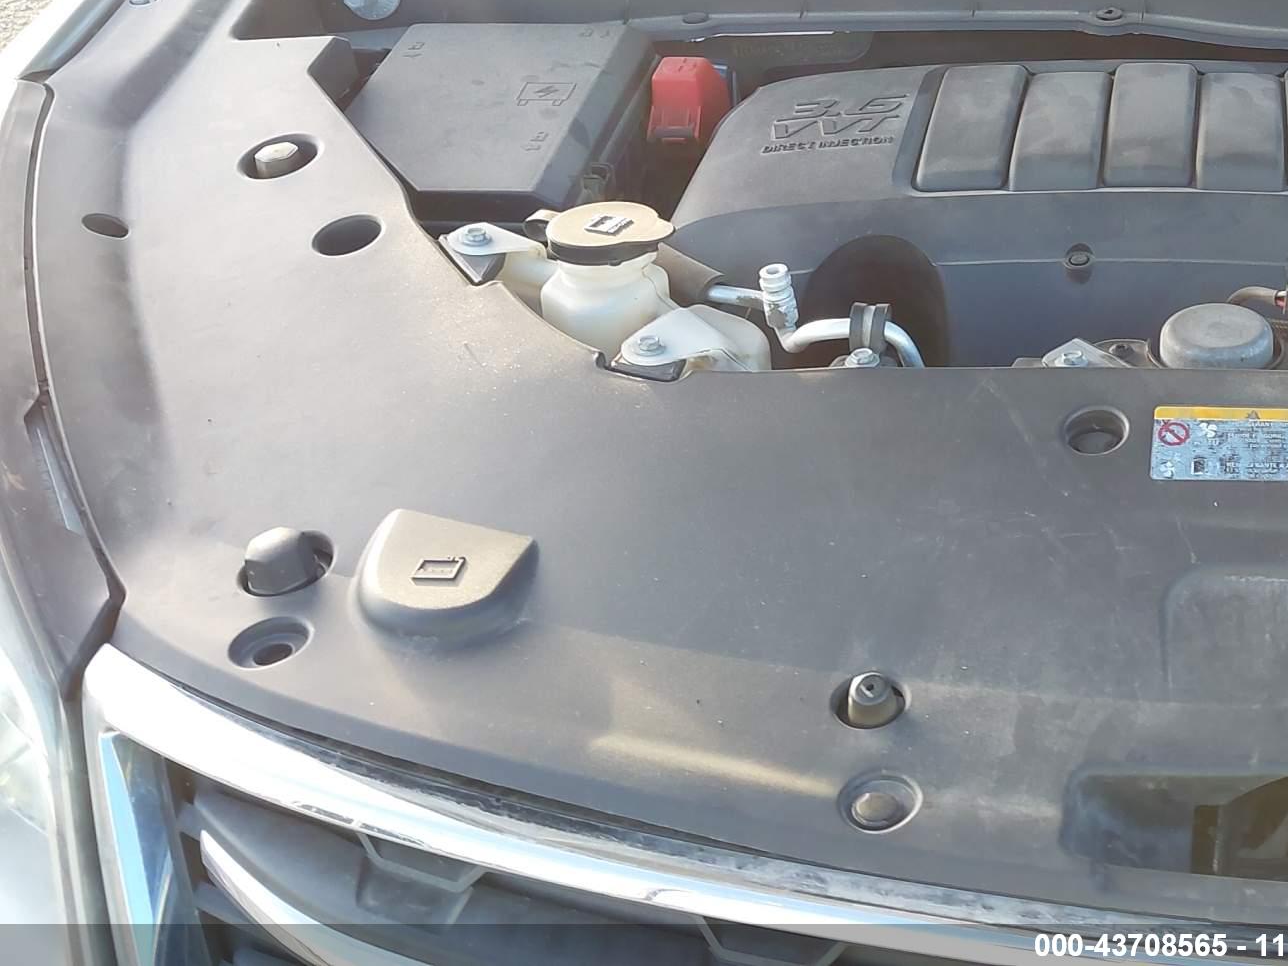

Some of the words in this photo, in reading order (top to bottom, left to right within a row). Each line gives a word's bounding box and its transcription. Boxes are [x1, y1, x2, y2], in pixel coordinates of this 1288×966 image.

[794, 94, 907, 117] 3.6
[772, 115, 899, 139] VVT
[760, 141, 814, 155] DIRECT
[818, 136, 896, 149] INJECTION
